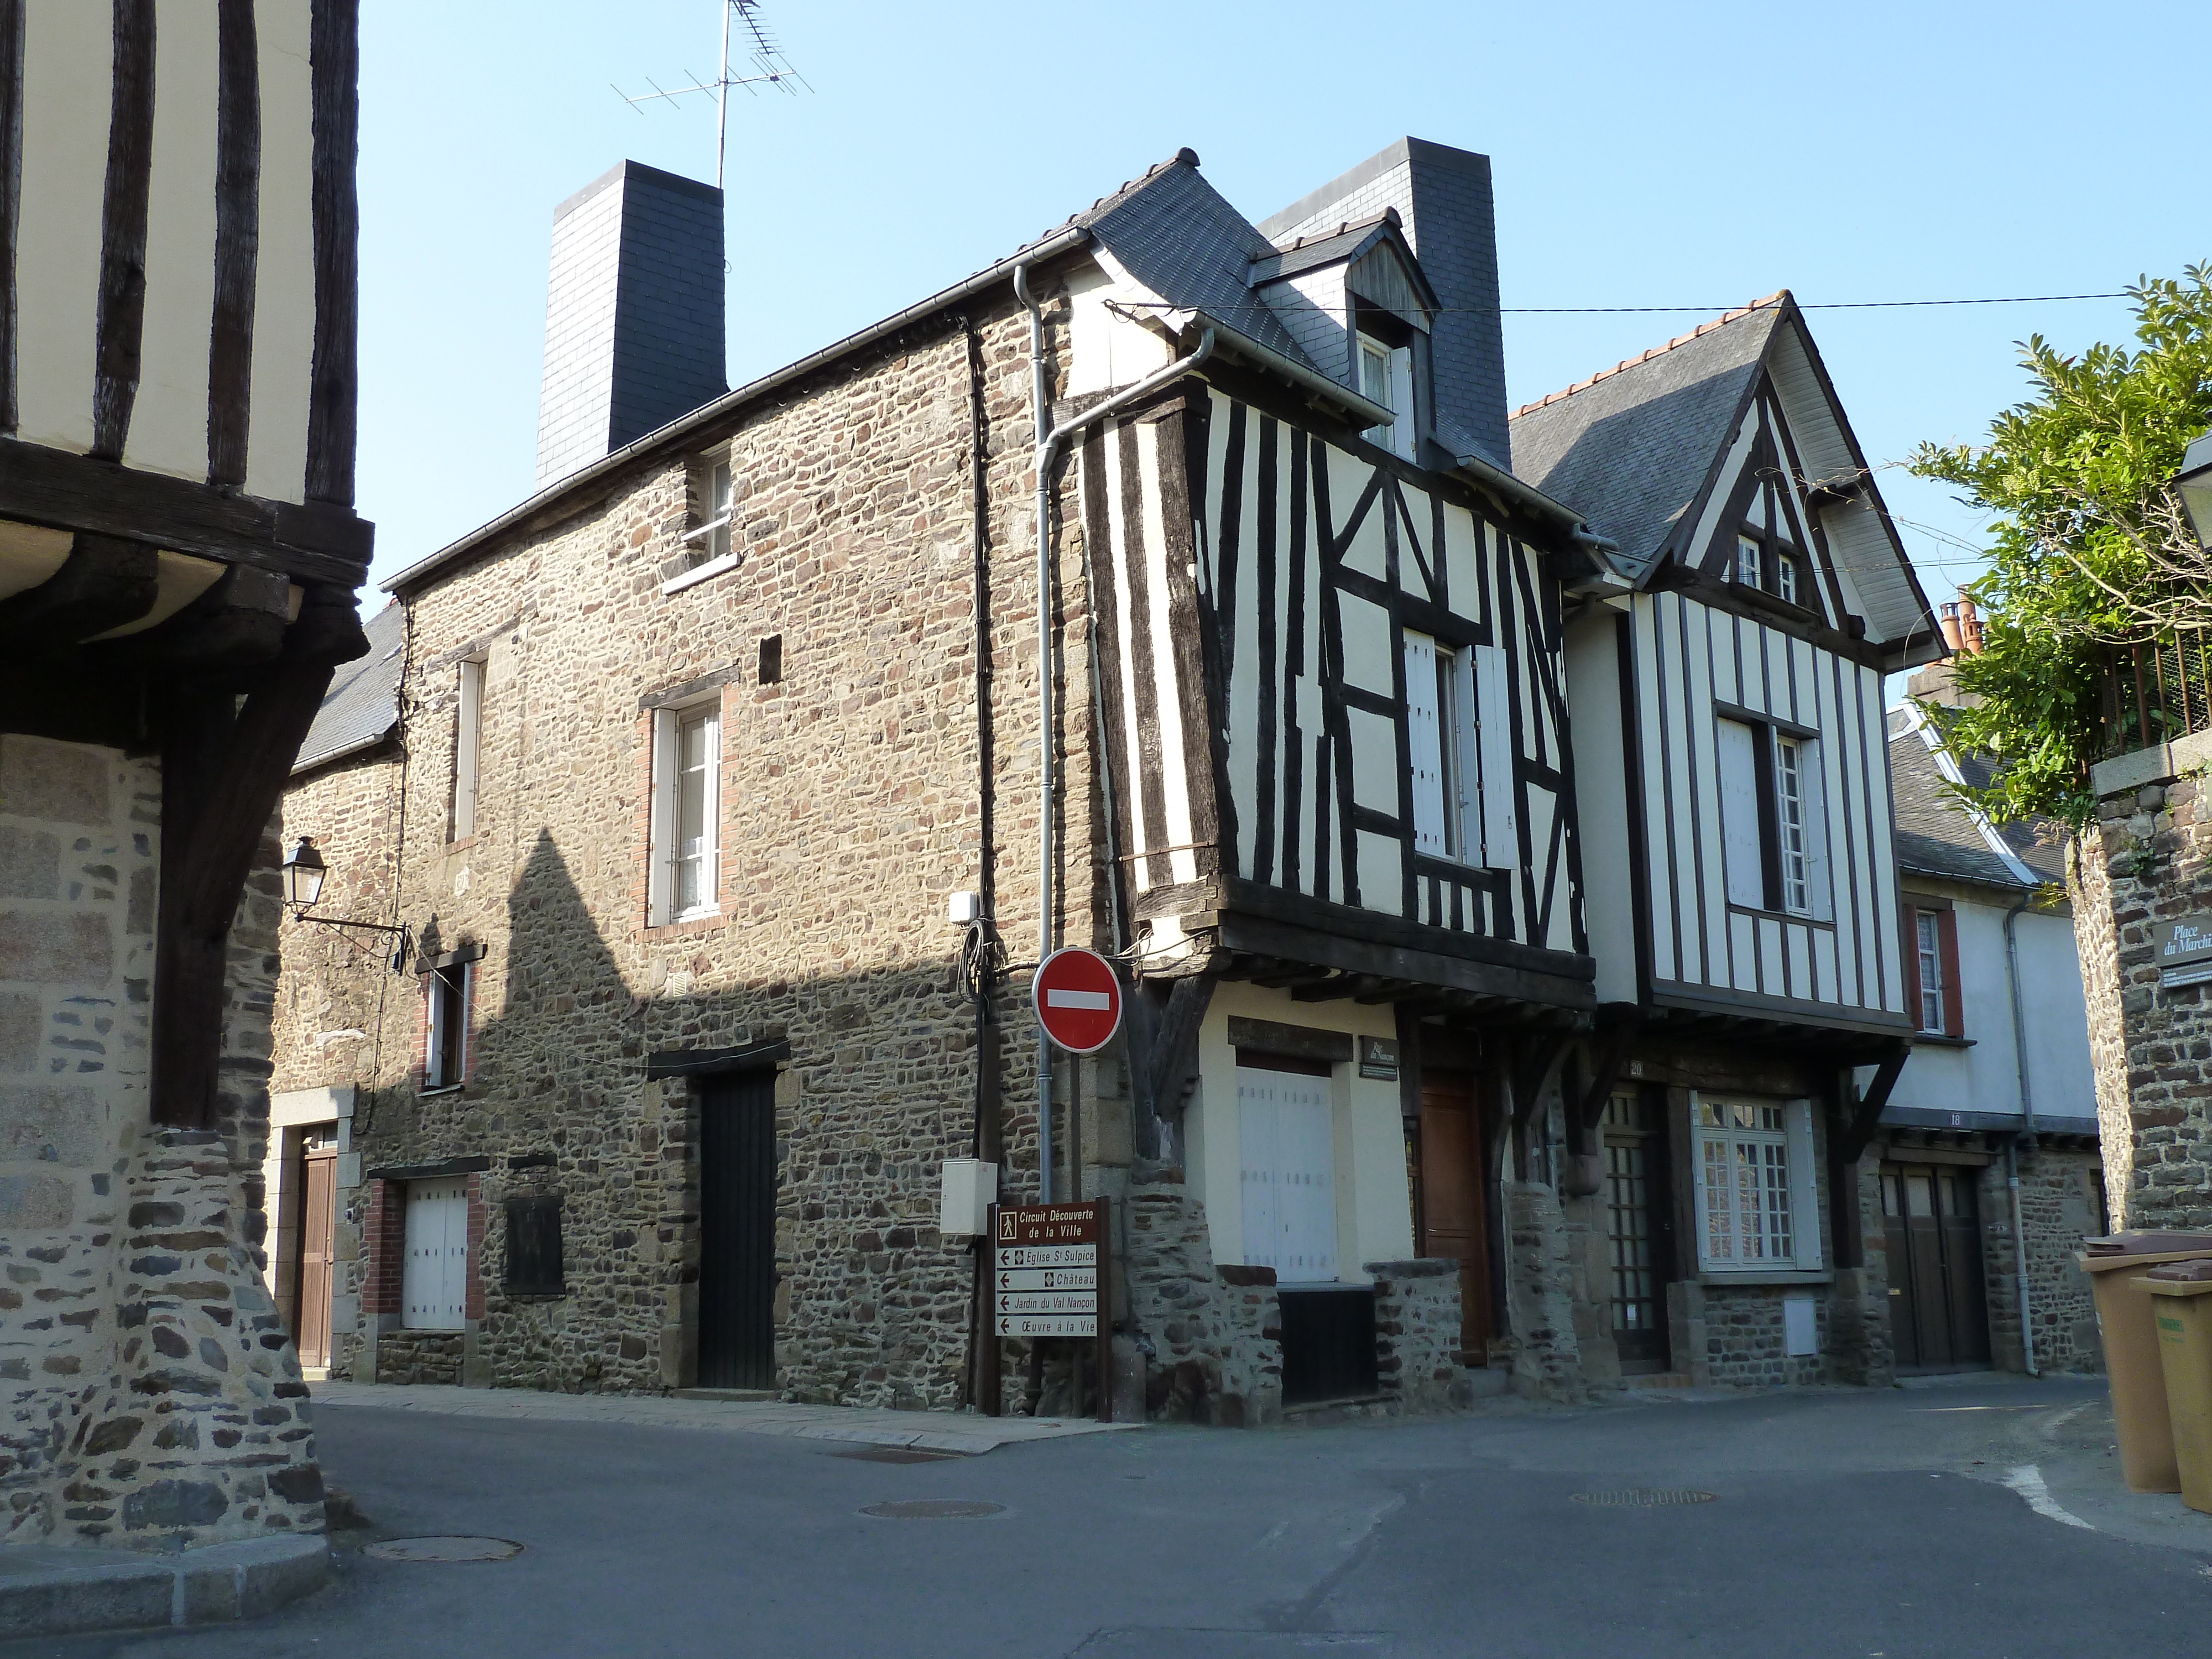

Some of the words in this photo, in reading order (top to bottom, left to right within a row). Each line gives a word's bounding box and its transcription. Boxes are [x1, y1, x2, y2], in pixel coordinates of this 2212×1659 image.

[2173, 925, 2198, 940] Place
[2164, 941, 2176, 956] du
[1632, 1062, 1641, 1075] 20
[1951, 1114, 1960, 1125] 18
[1020, 1211, 1046, 1223] Circuit
[1050, 1209, 1093, 1221] Découverte
[1029, 1228, 1040, 1238] de
[1046, 1226, 1054, 1238] la
[1060, 1225, 1082, 1237] Ville
[1026, 1249, 1050, 1265] Église
[1053, 1251, 1063, 1261] St
[1065, 1249, 1094, 1264] Sulpice
[1056, 1274, 1094, 1285] Château
[1015, 1297, 1037, 1309] Jardin
[1041, 1297, 1050, 1308] du
[1053, 1297, 1065, 1308] Val
[1067, 1296, 1094, 1310] Nançon
[1022, 1321, 1051, 1332] Œuvre
[1057, 1321, 1062, 1332] à
[1066, 1320, 1074, 1332] la
[1080, 1319, 1095, 1332] Vie
